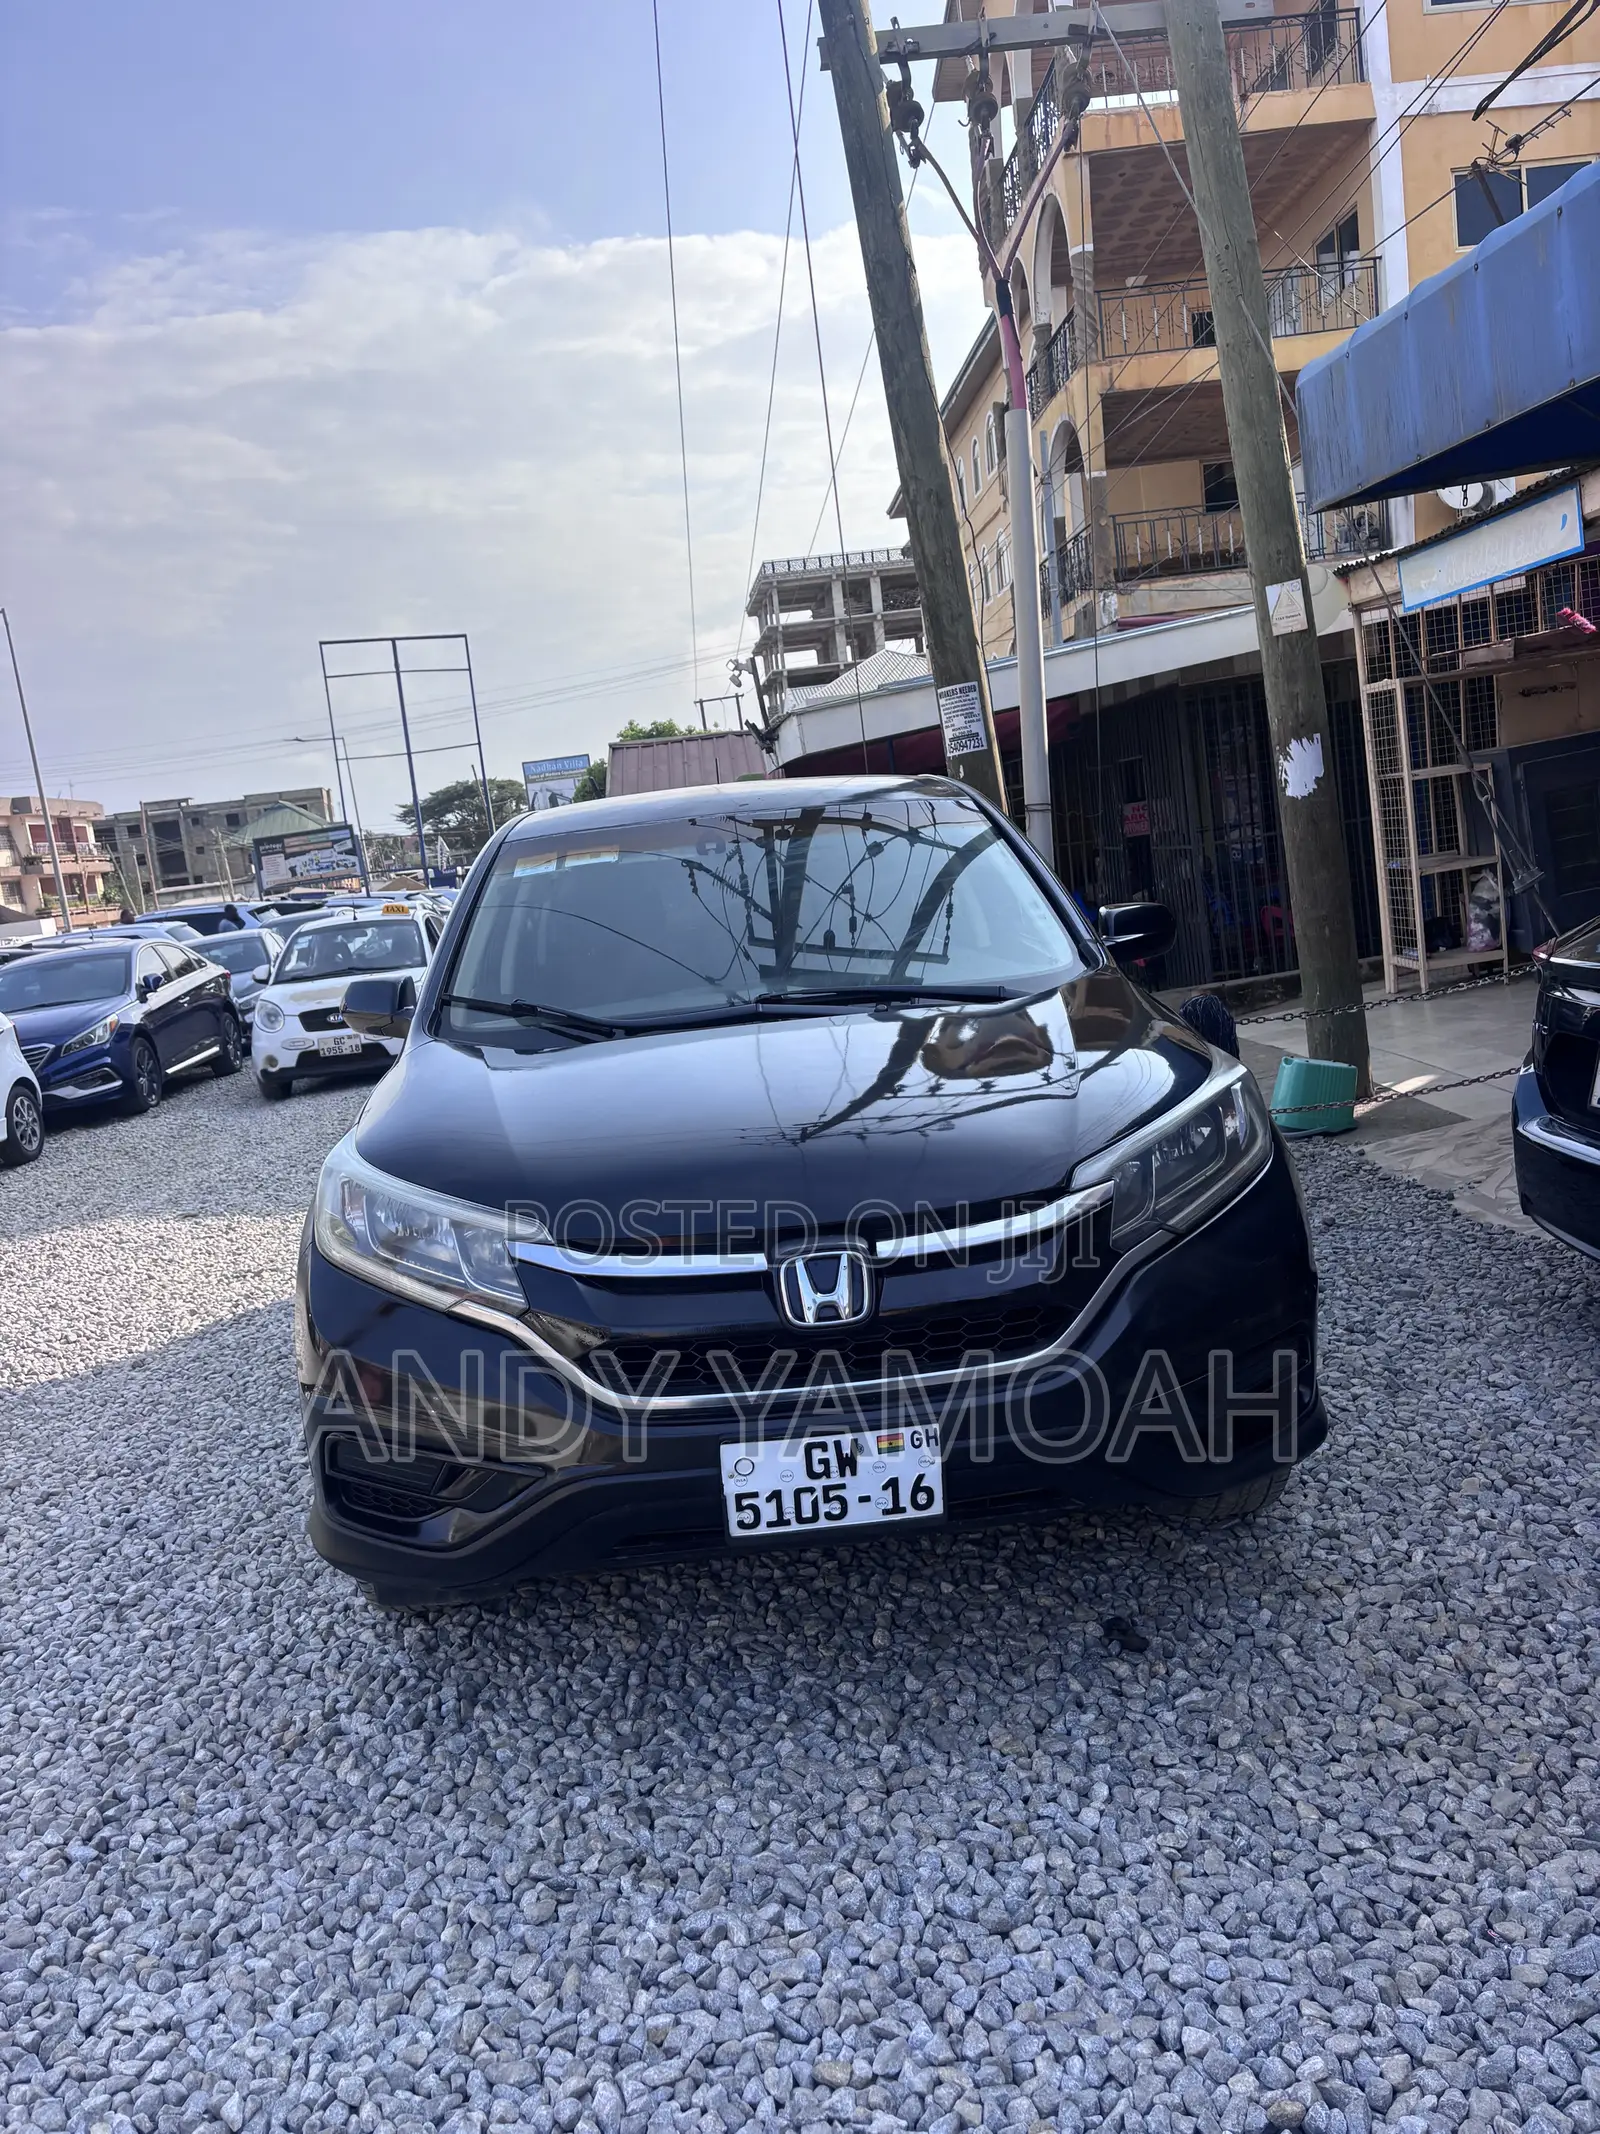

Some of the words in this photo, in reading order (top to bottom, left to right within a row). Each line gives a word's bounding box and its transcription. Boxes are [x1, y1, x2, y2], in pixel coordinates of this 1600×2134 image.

[939, 687, 959, 699] WORKERS
[959, 684, 977, 695] NEEDED
[563, 759, 584, 769] Villa
[385, 905, 405, 913] TAXI
[333, 1037, 346, 1046] GC
[321, 1044, 361, 1056] 1955-18
[803, 1437, 859, 1480] GW
[910, 1427, 939, 1450] GH
[734, 1473, 935, 1530] 5105-16
